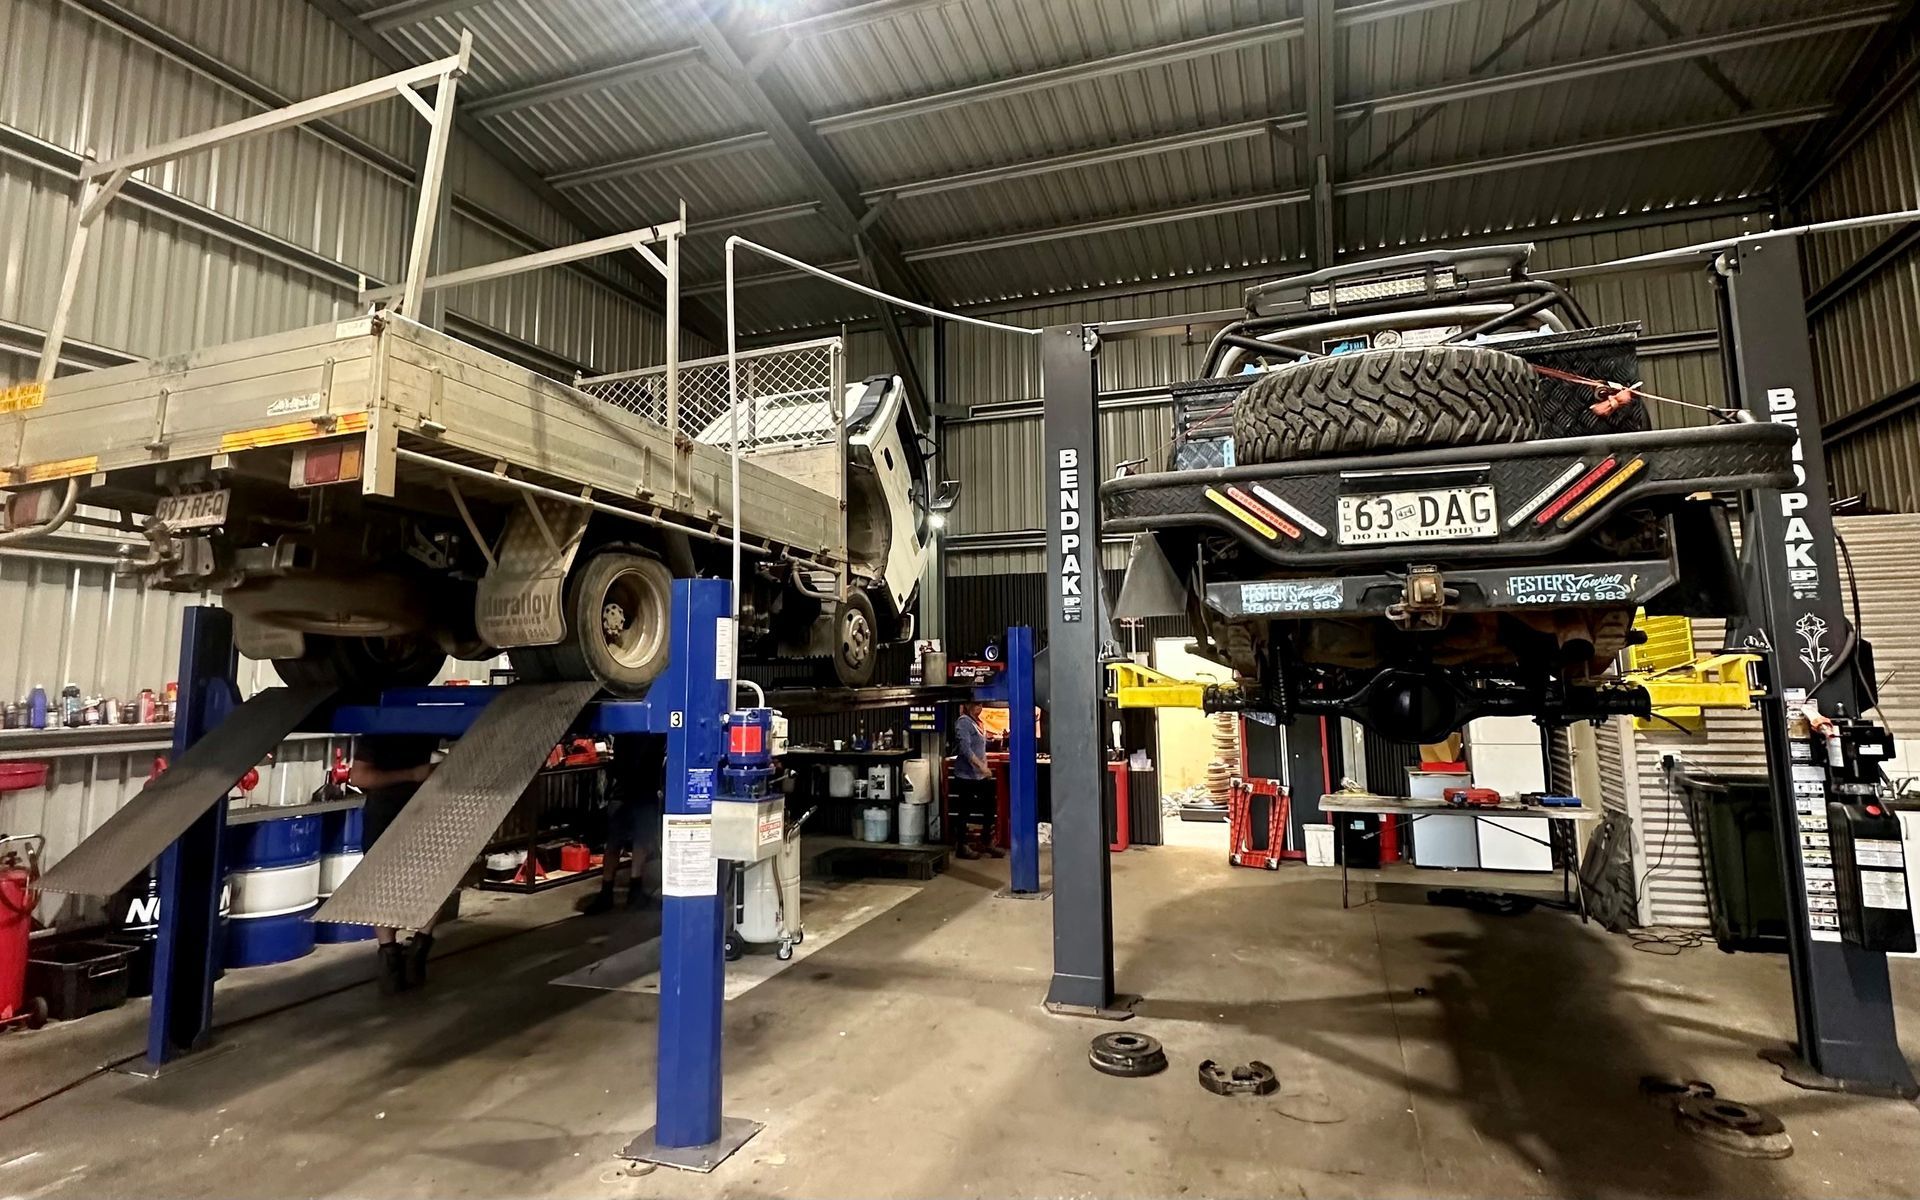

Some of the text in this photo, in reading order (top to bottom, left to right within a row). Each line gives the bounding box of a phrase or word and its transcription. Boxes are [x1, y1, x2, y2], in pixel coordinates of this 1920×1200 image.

[1355, 500, 1393, 531] 63
[1418, 492, 1491, 527] DAG
[1059, 449, 1081, 596] BENDPAK
[1352, 533, 1371, 541] DO
[1376, 532, 1389, 540] IT
[1395, 530, 1410, 538] IN
[1448, 526, 1484, 536] DIRT
[1508, 573, 1623, 596] FESTER'S Towing
[1241, 585, 1298, 604] FESTER'S
[1516, 591, 1627, 604] 0407 576 983
[1248, 600, 1340, 613] 0407 576 983
[672, 712, 681, 727] 3
